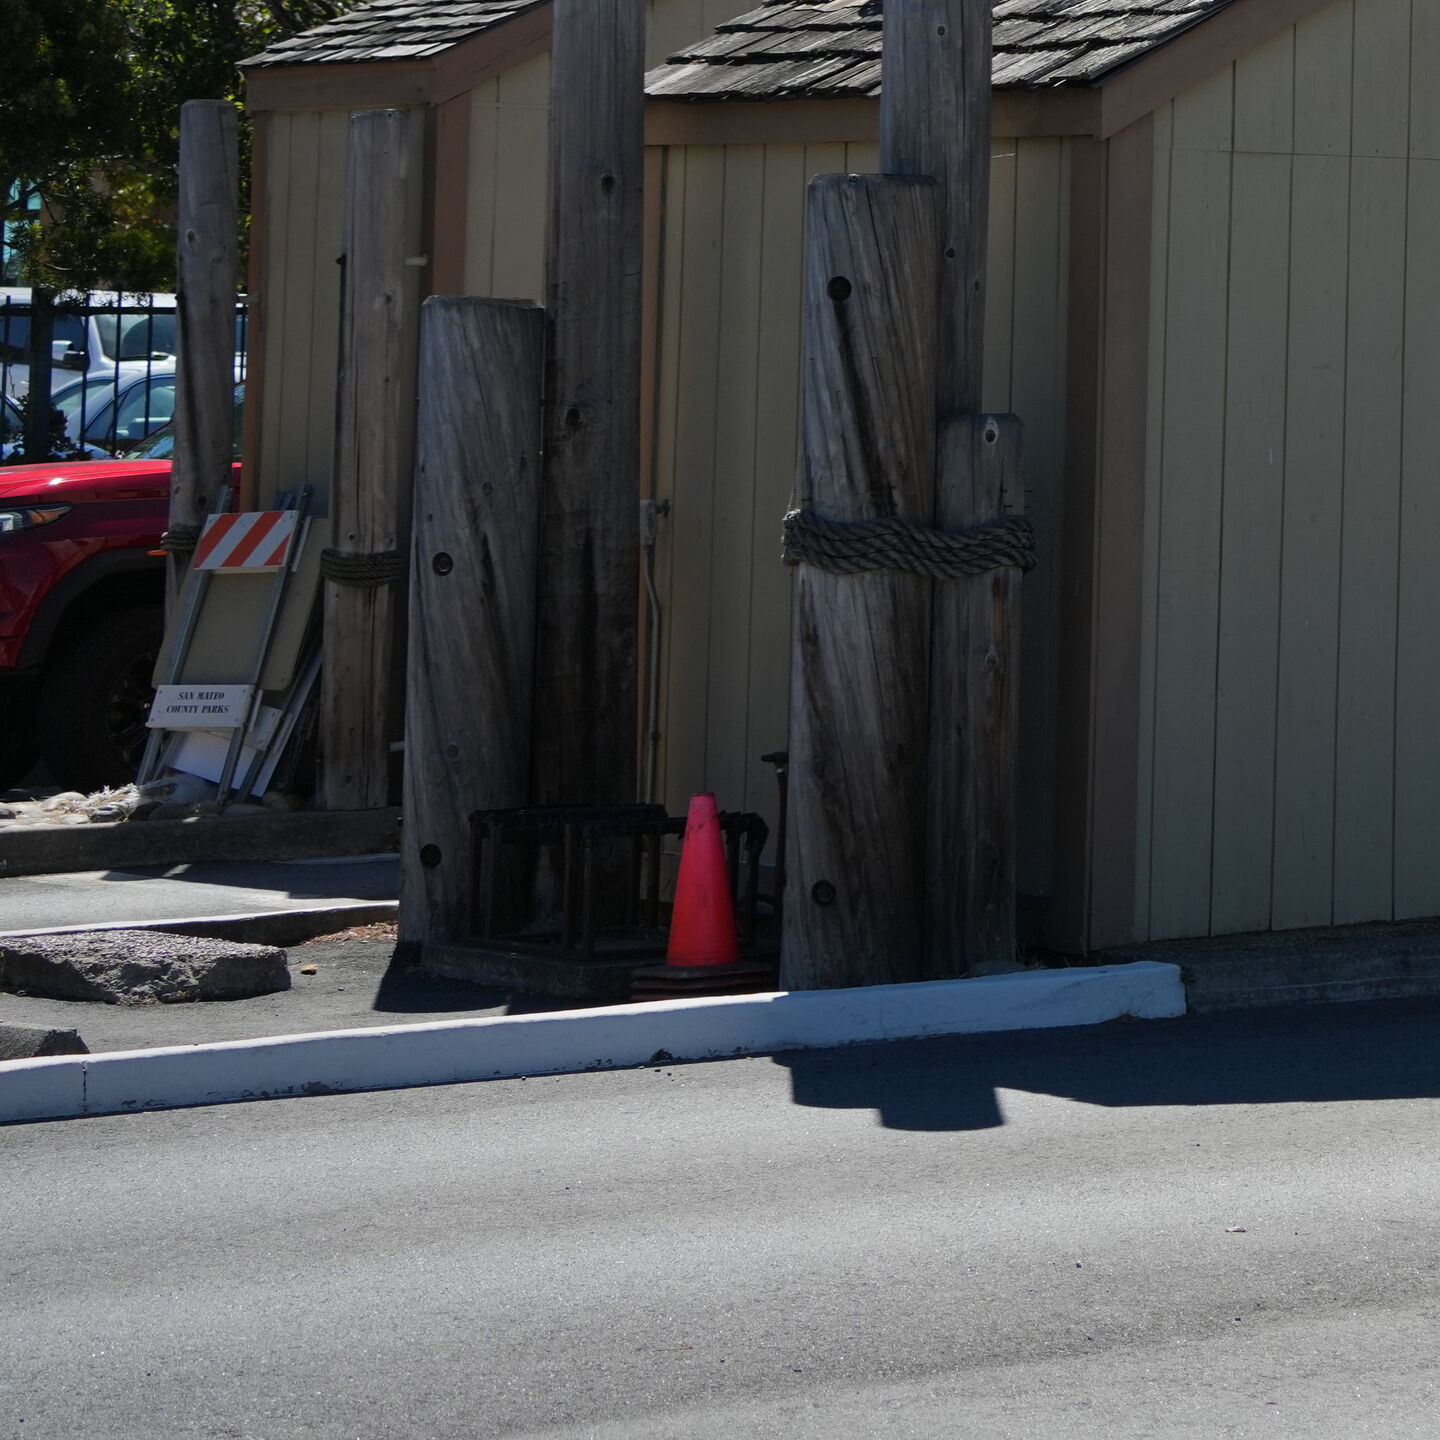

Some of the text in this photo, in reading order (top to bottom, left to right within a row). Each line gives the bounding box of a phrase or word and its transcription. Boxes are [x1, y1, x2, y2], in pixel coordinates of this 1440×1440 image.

[178, 691, 225, 700] SAN MATEO
[166, 705, 229, 713] COUNTY PARKS
